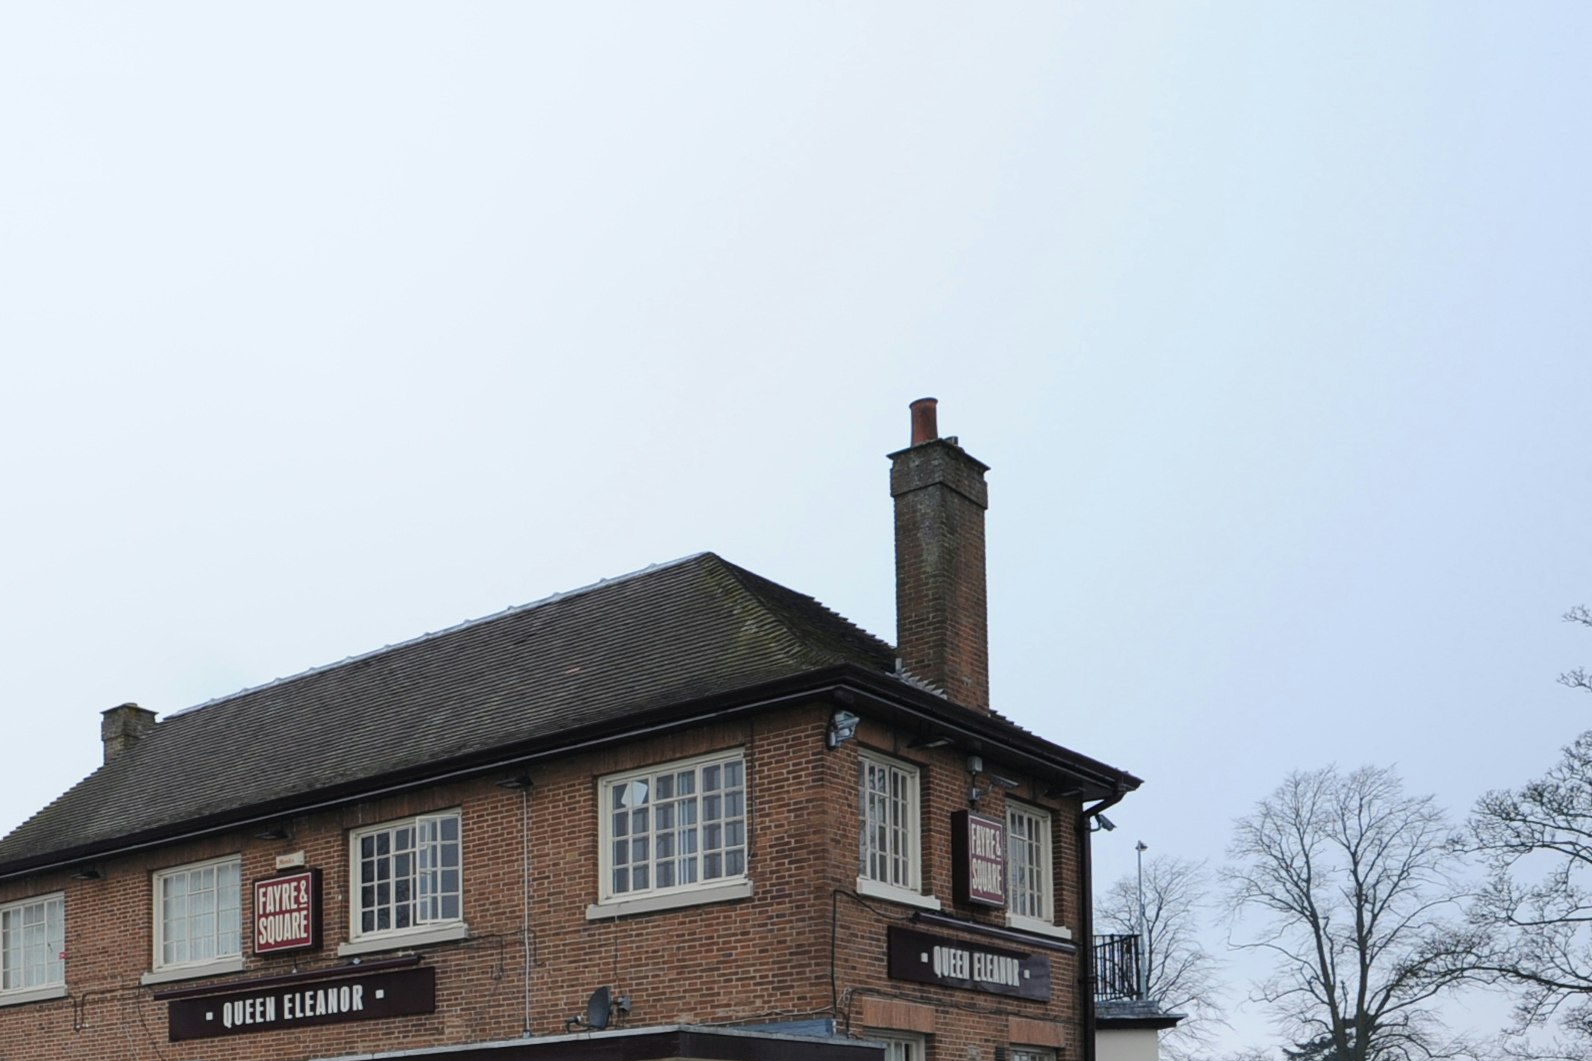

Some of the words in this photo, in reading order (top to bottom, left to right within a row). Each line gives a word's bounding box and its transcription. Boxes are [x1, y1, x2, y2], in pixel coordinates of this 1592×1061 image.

[971, 823, 995, 859] FAYRE
[972, 857, 1002, 895] SQUARE
[259, 881, 298, 915] FAYRE
[299, 879, 308, 908] &
[258, 910, 308, 945] SQUARE
[933, 945, 970, 979] QUEEN
[973, 952, 1020, 987] ELEANOR
[223, 996, 276, 1028] QUEEN
[283, 984, 363, 1020] ELEANOR
